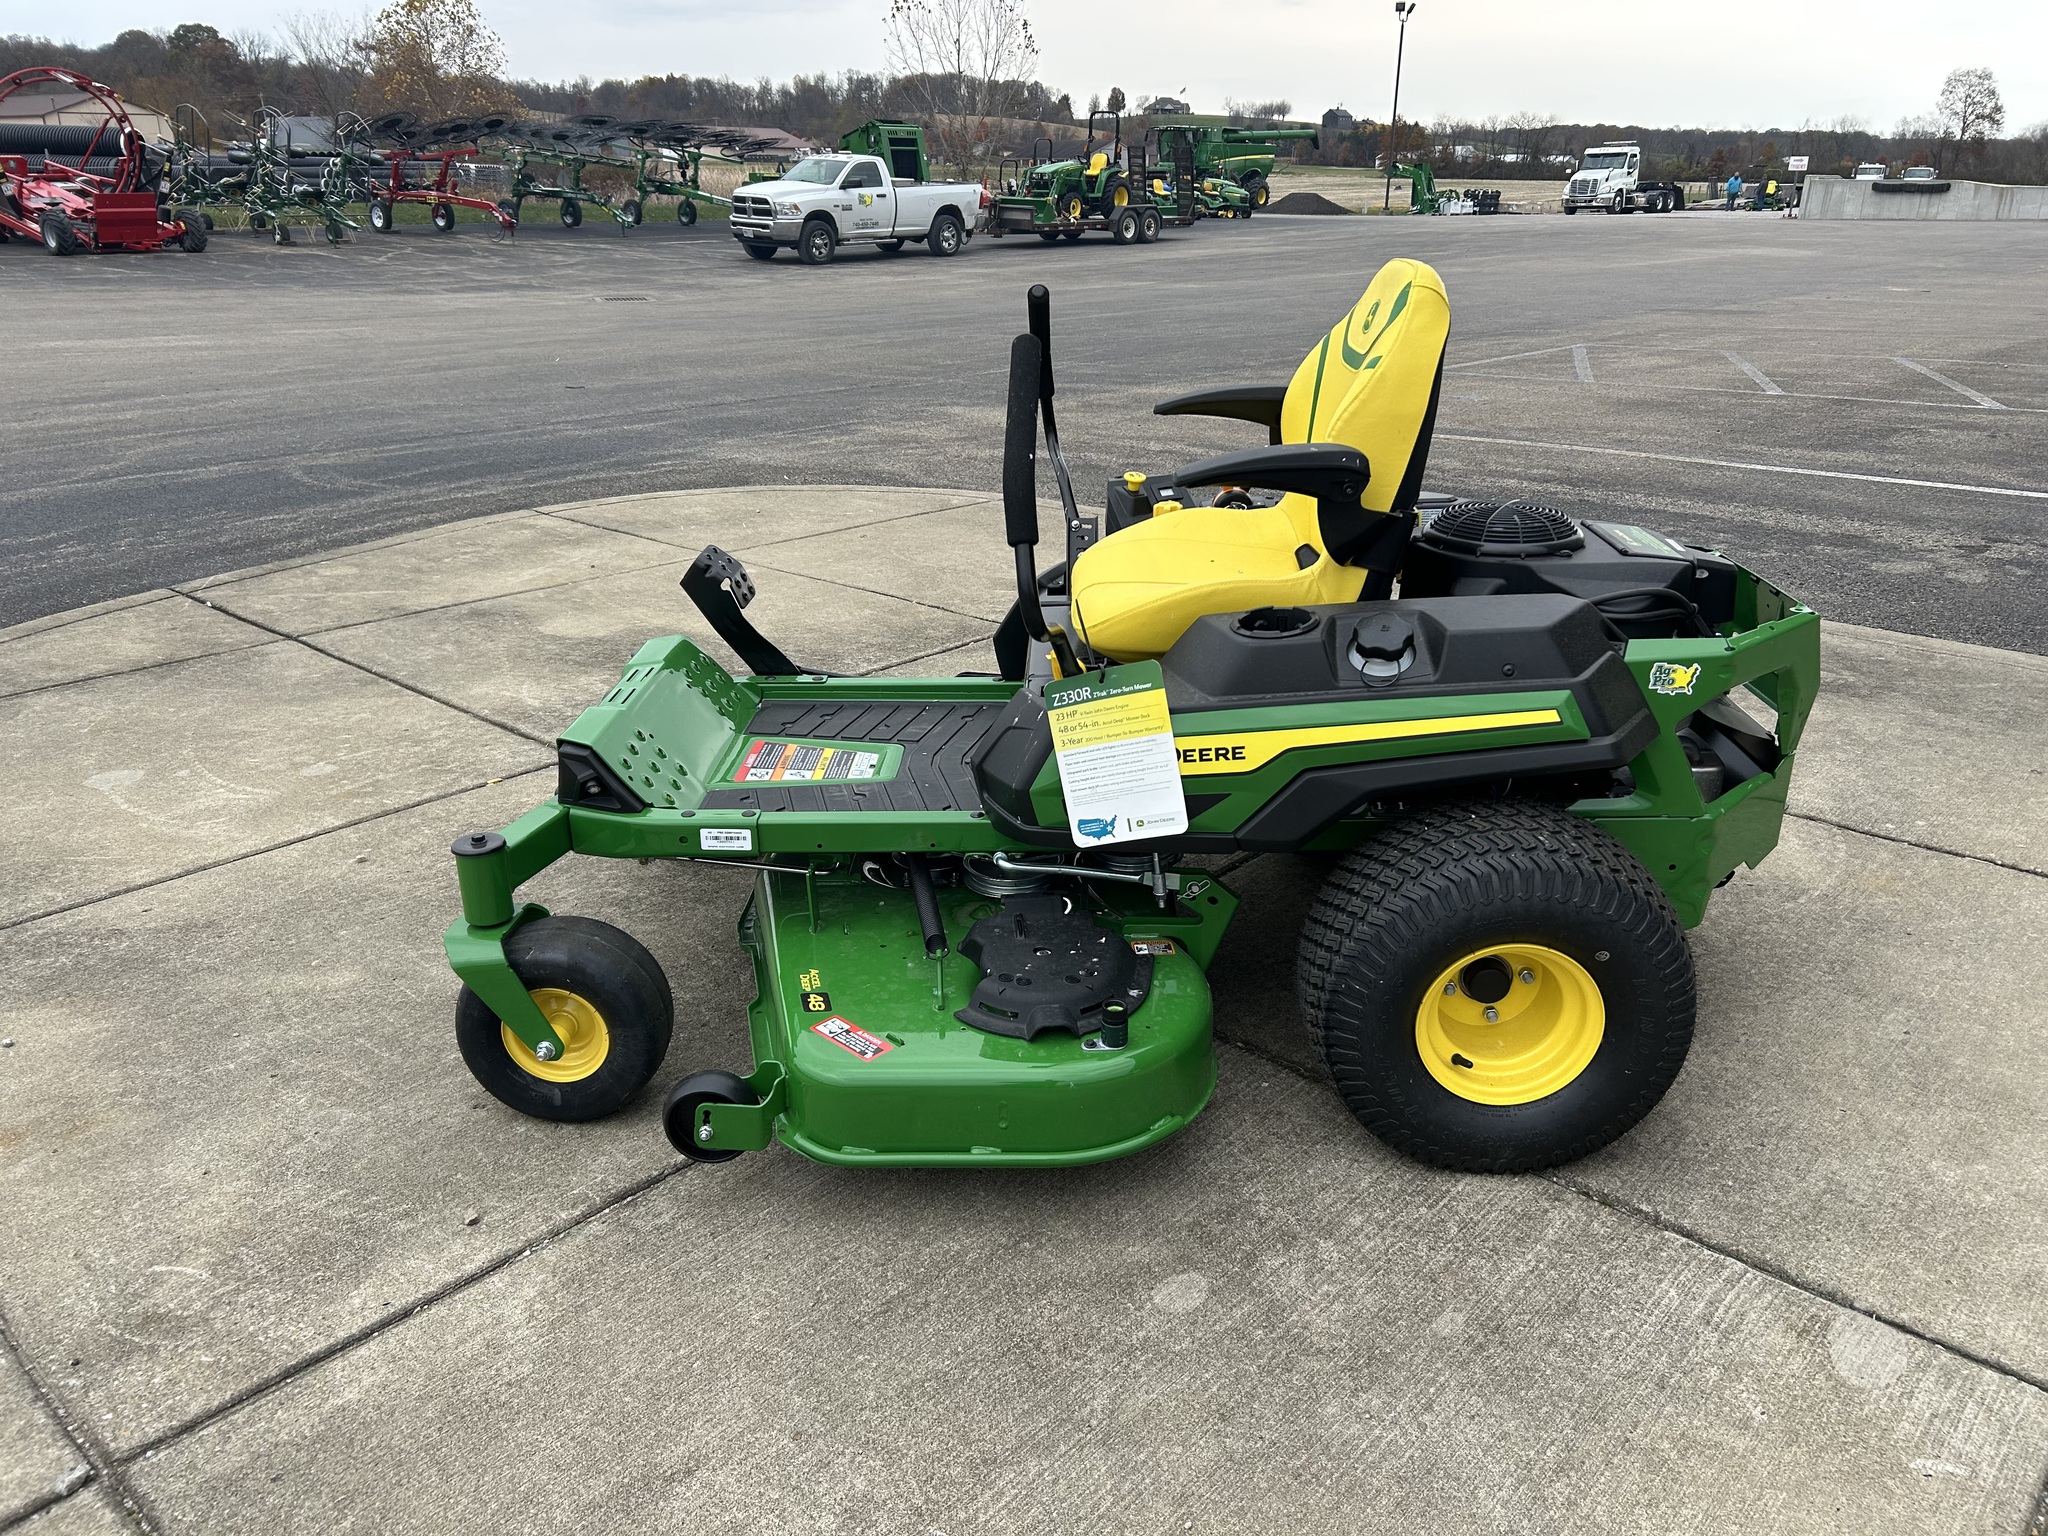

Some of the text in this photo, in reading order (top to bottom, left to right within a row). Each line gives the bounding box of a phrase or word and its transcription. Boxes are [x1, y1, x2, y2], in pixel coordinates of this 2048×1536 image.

[1654, 666, 1677, 677] Ag-
[1652, 676, 1675, 686] Pro
[1052, 687, 1092, 706] Z330R
[1110, 684, 1134, 695] Zero-Turn
[1134, 682, 1152, 690] Mower
[1055, 712, 1064, 721] 23
[1058, 725, 1069, 734] 48
[1060, 735, 1083, 747] 3-Year
[800, 974, 811, 992] DEEP
[809, 968, 821, 989] ACCEL
[807, 993, 826, 1011] 48
